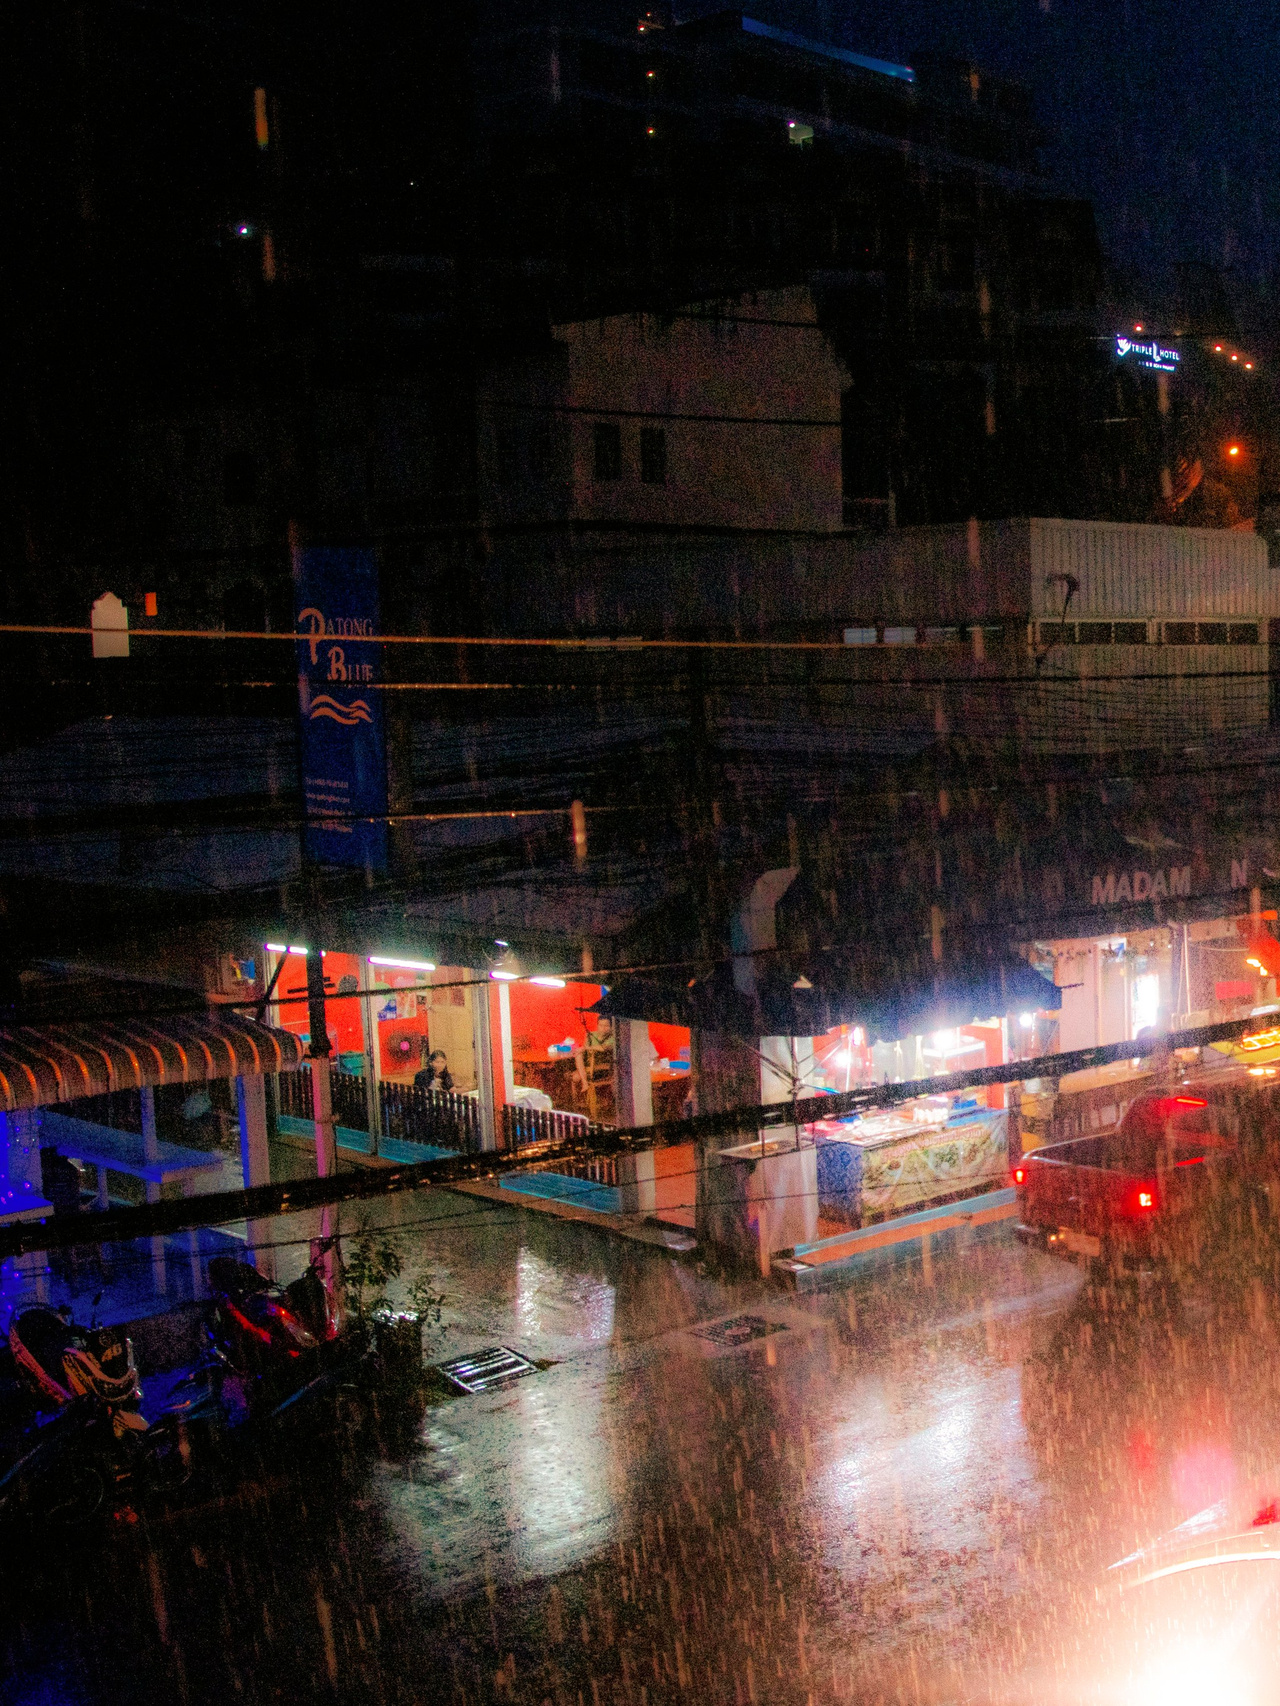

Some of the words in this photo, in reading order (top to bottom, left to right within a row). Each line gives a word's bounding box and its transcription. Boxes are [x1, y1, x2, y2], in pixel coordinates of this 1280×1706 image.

[1131, 343, 1152, 356] TRIPLE
[1159, 349, 1180, 361] HOTEL
[1091, 865, 1191, 905] MADAM
